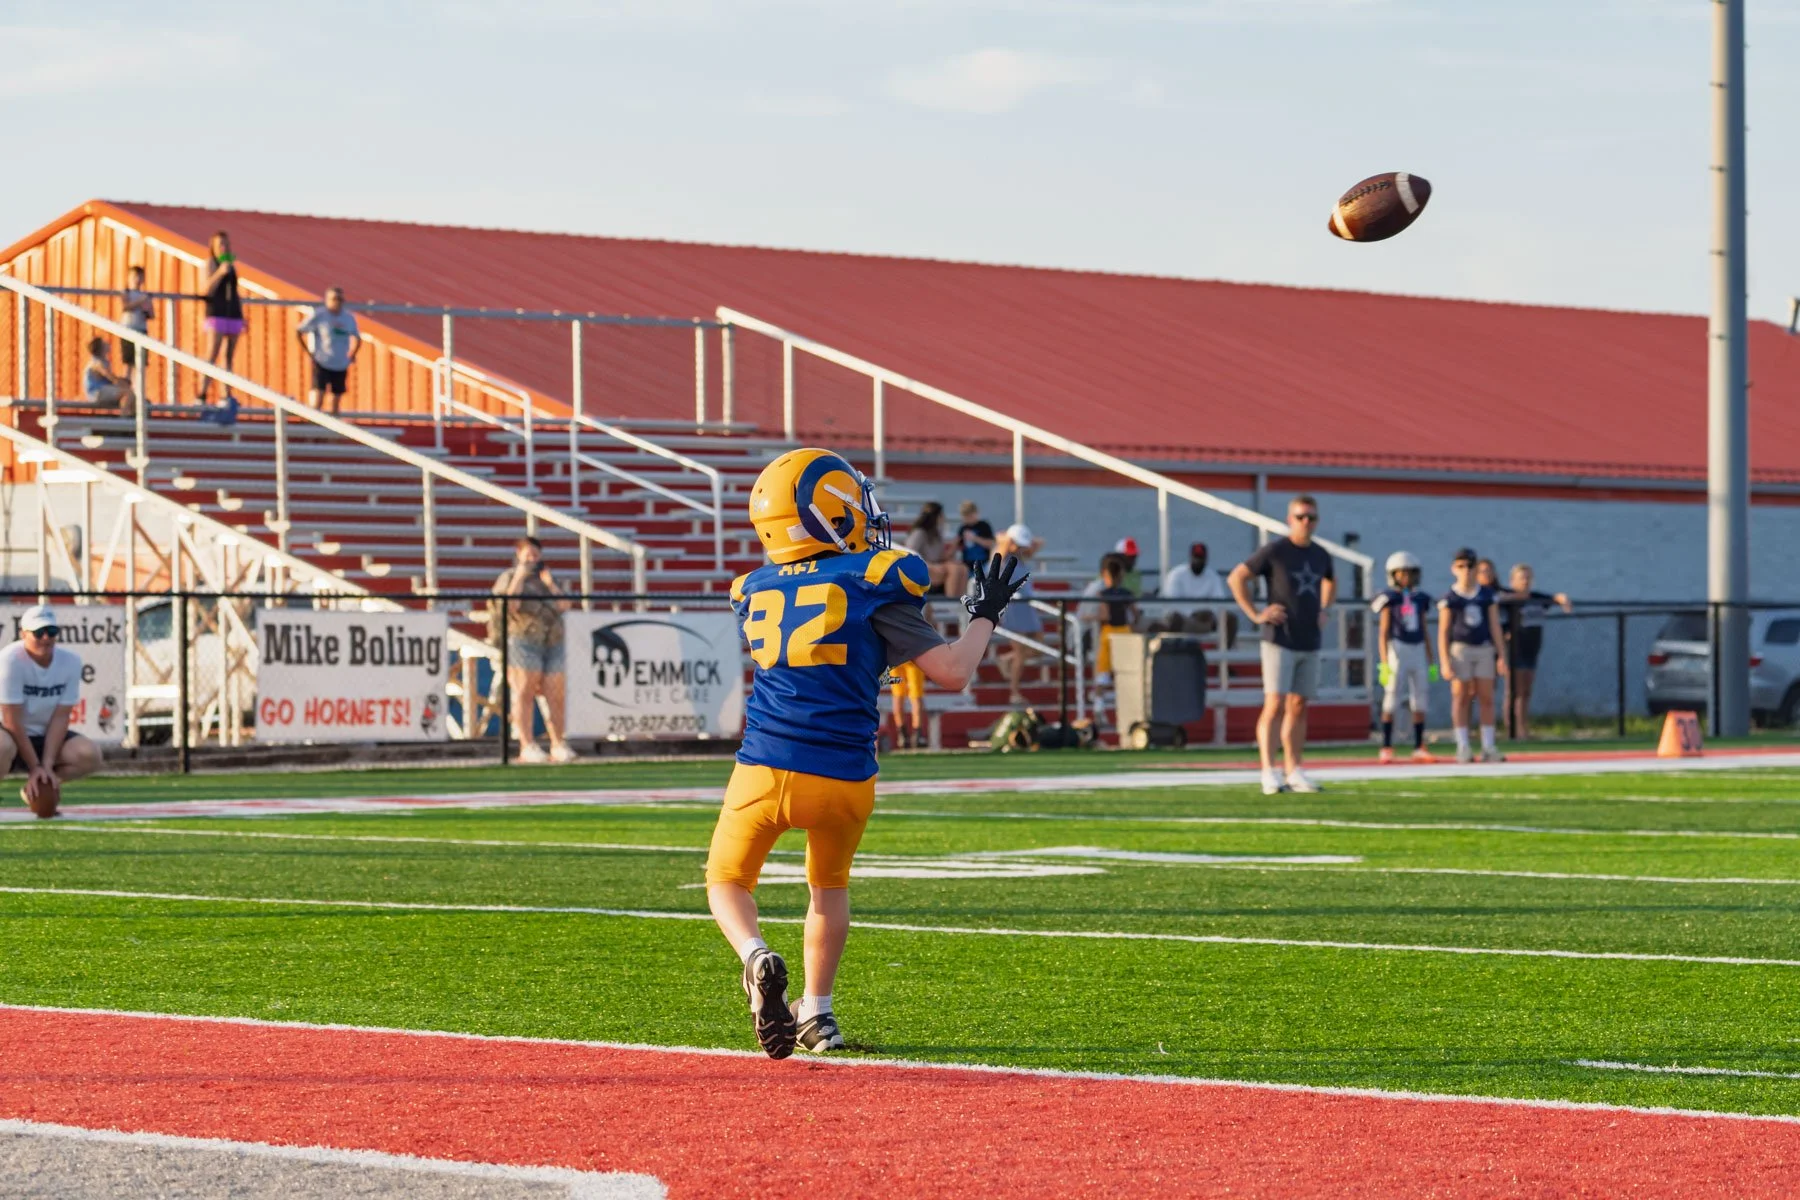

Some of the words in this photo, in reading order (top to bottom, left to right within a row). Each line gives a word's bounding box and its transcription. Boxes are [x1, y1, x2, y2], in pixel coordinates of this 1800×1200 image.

[743, 583, 848, 670] 82
[263, 623, 340, 666] Mike
[348, 625, 442, 677] Boling
[260, 697, 295, 726] GO
[304, 697, 412, 728] HORNETS!
[634, 688, 661, 704] EYE
[669, 687, 710, 704] CARE
